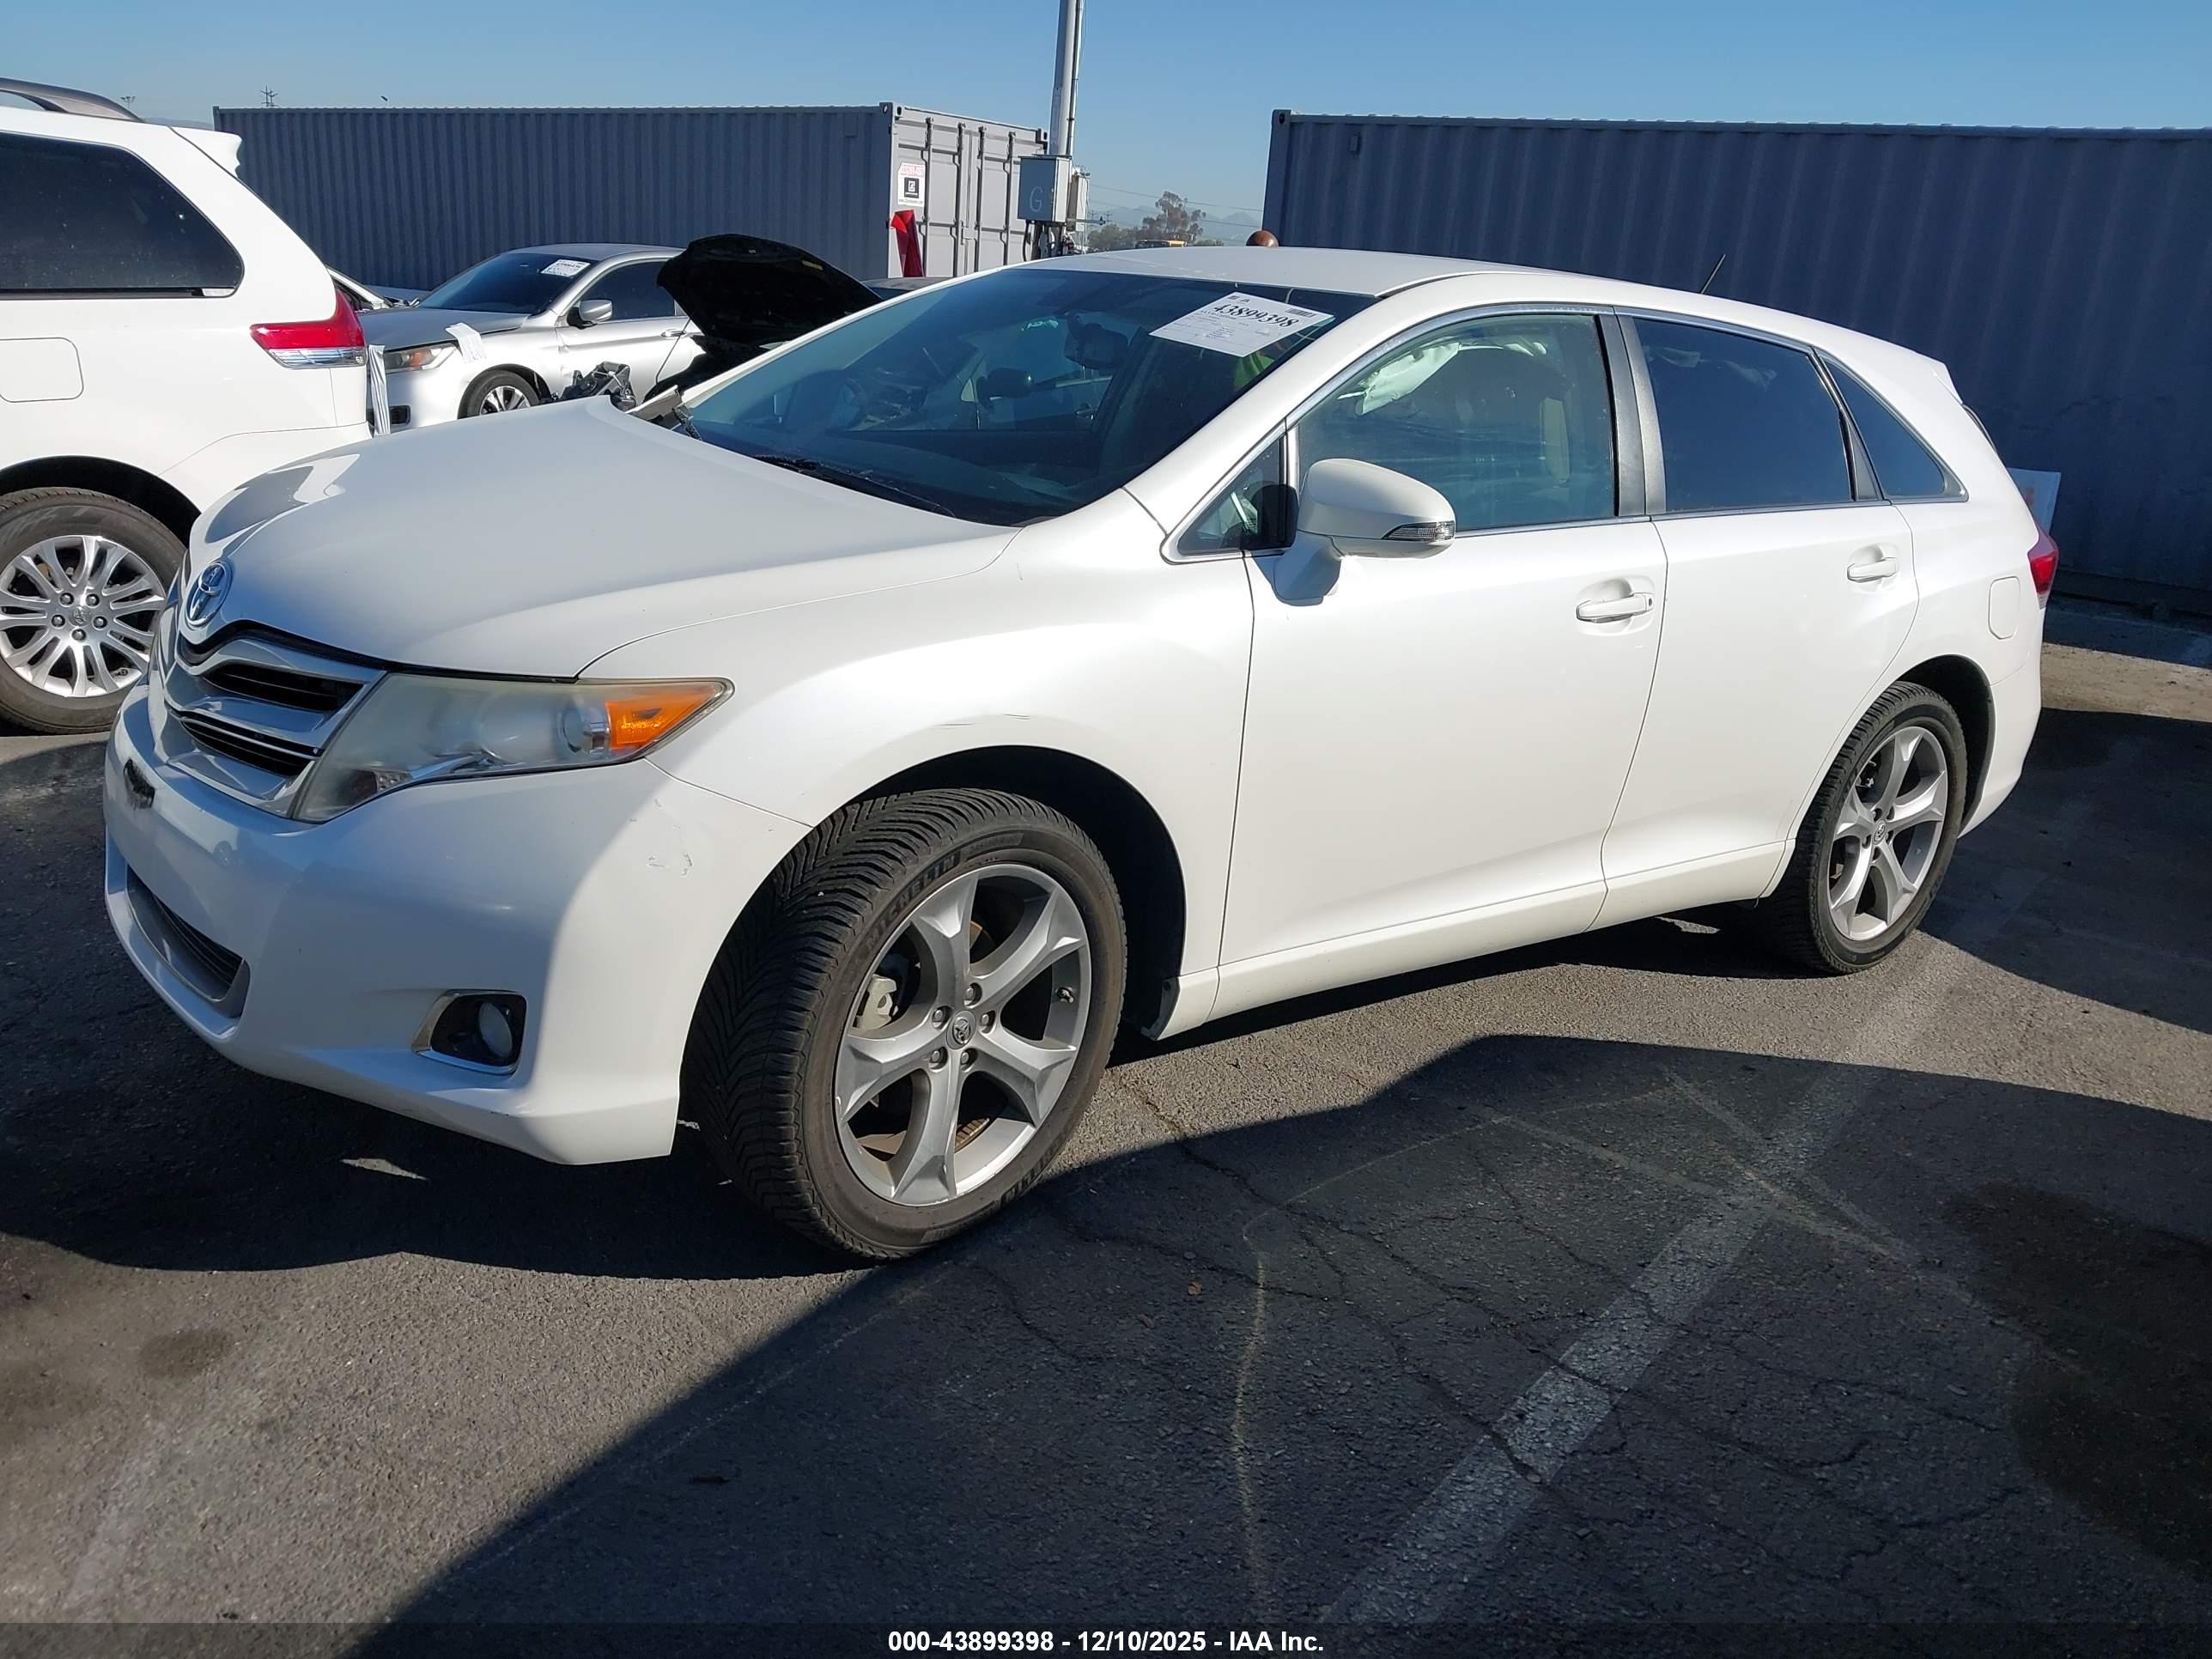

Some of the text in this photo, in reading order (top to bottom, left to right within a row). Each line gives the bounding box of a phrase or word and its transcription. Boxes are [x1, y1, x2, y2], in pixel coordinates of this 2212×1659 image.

[1030, 185, 1042, 212] G
[1213, 303, 1299, 327] 43899398
[865, 854, 957, 950] MICHELIN
